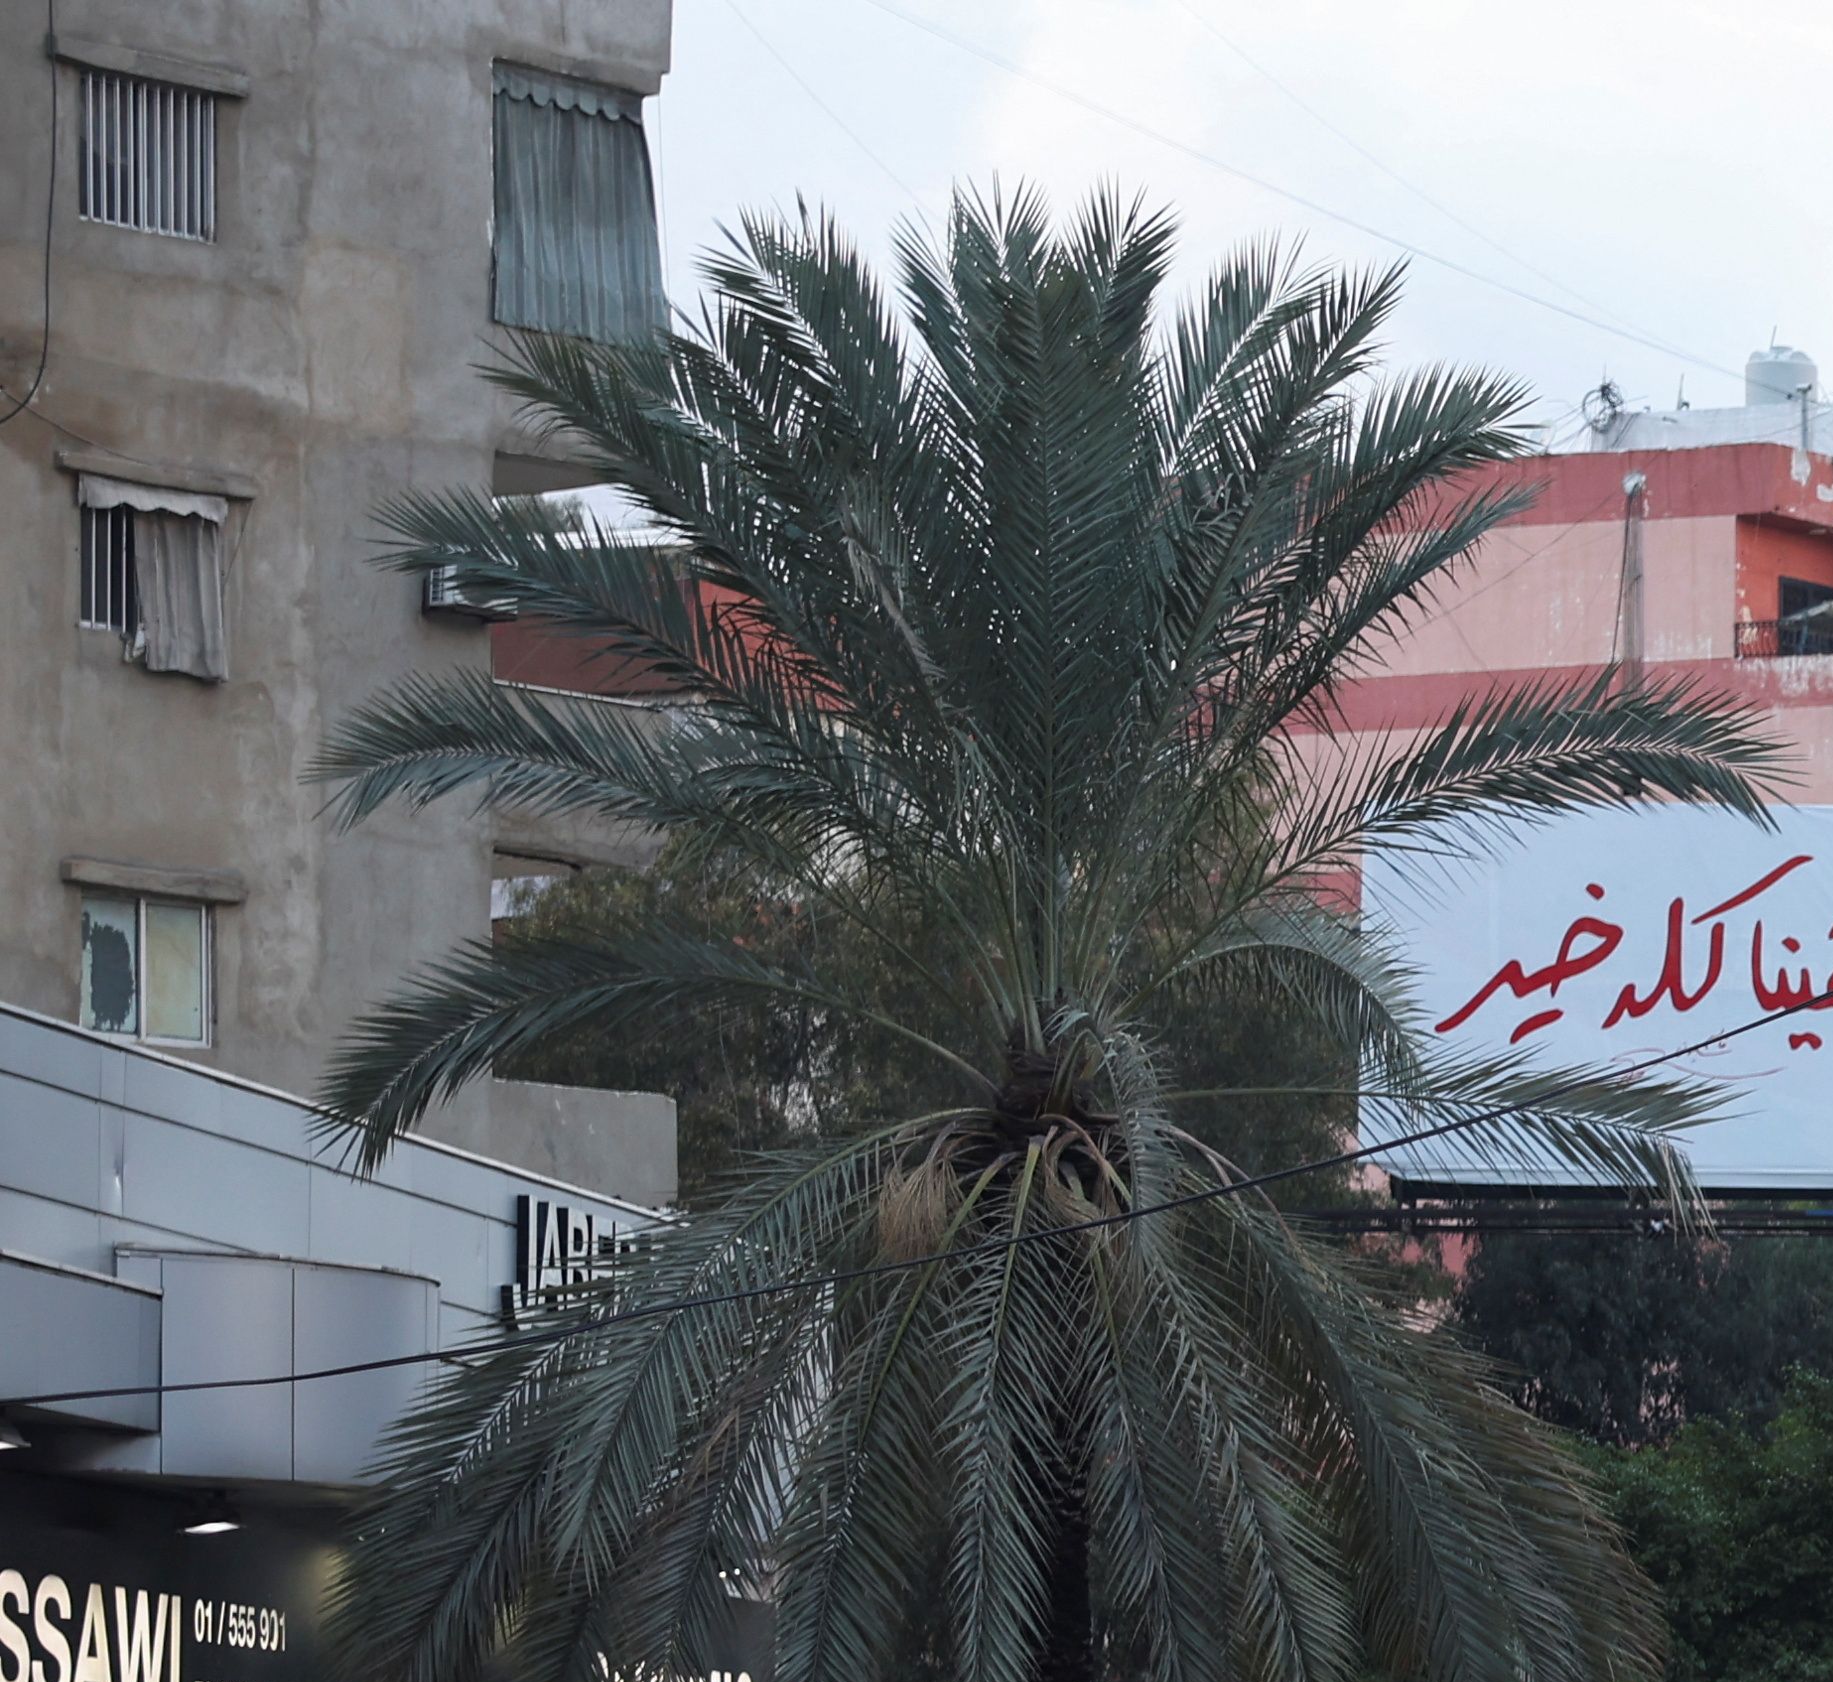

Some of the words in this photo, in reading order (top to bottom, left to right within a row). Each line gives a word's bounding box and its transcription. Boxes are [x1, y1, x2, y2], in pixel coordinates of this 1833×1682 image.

[1435, 883, 1624, 1044] خير
[194, 1598, 213, 1644] 01
[228, 1603, 256, 1649] 555
